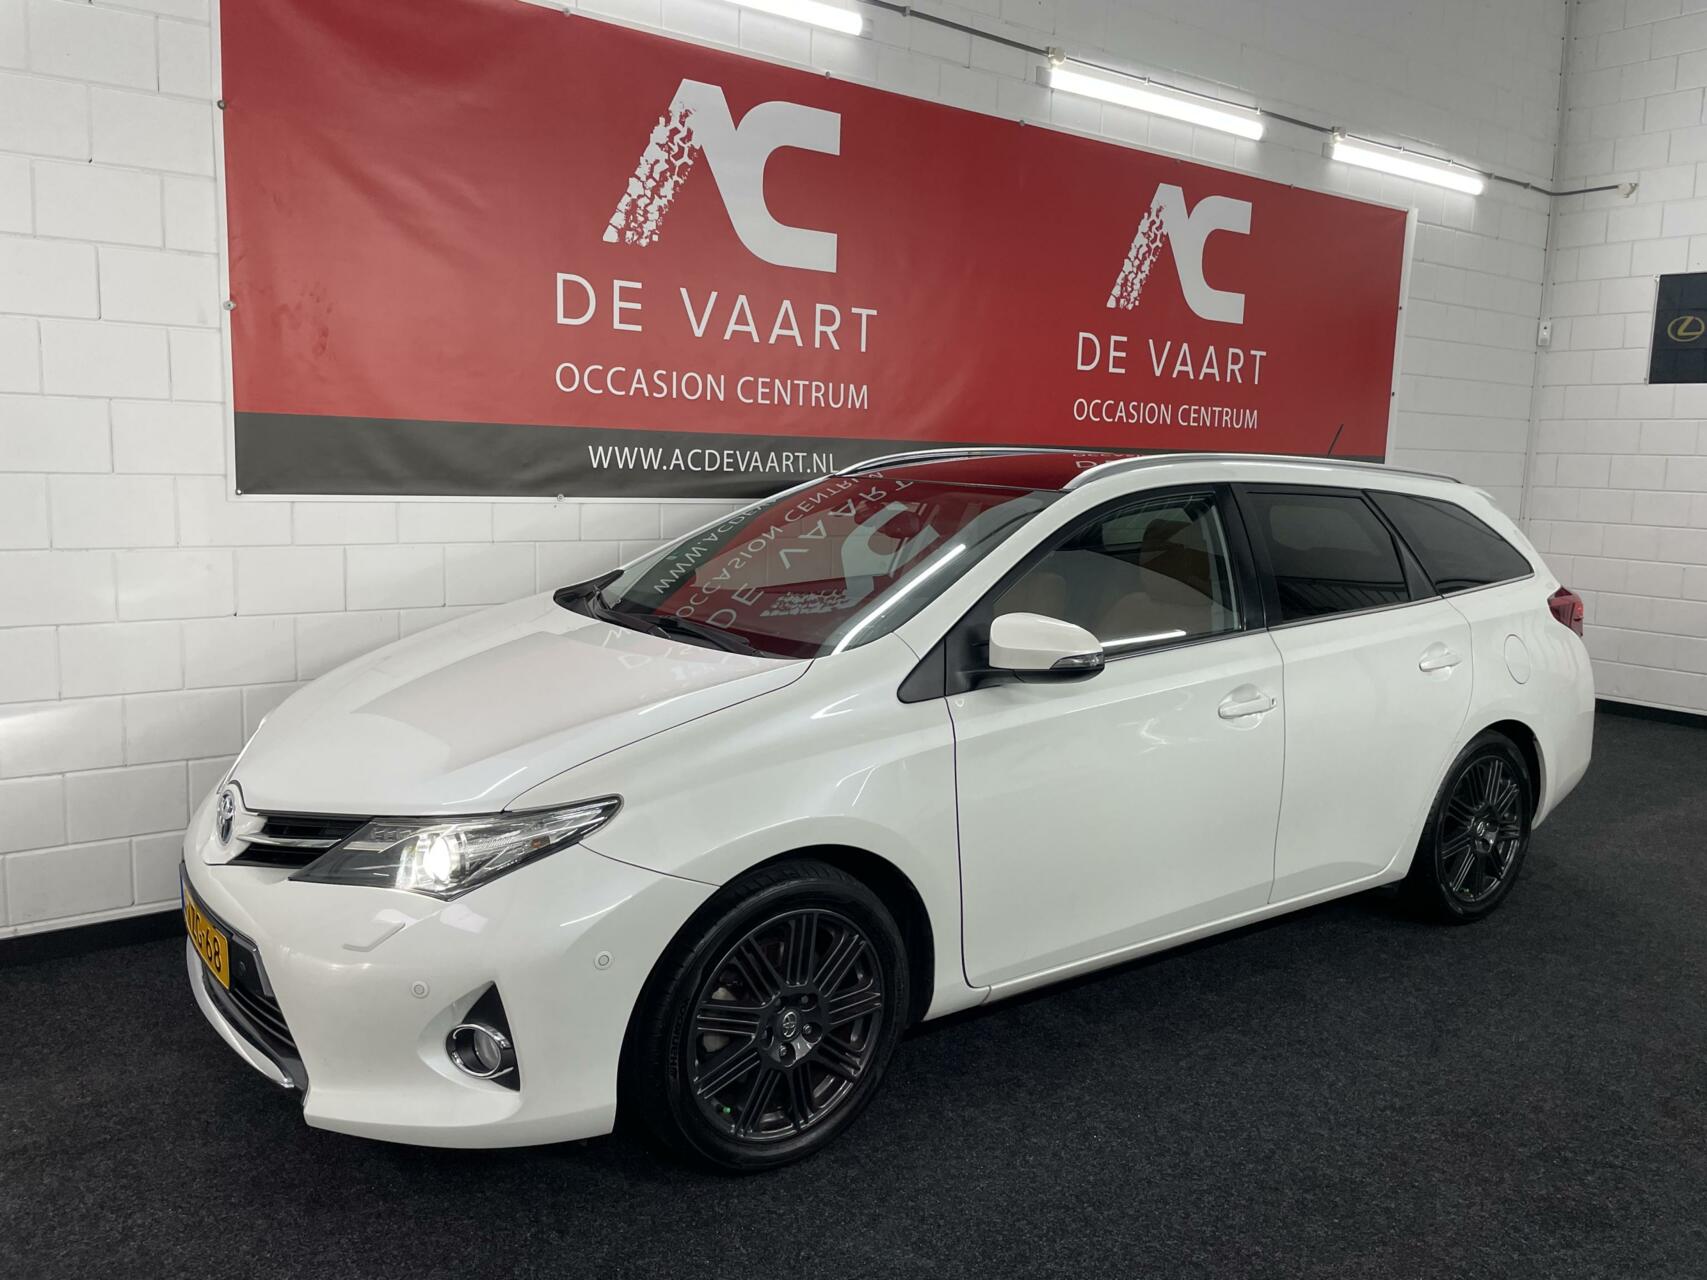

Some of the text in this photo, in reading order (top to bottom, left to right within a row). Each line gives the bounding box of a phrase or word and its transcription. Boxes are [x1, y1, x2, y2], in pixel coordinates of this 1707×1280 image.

[602, 78, 841, 273] AC
[1106, 182, 1252, 325] AC
[555, 272, 878, 353] DE VAART
[1076, 331, 1267, 385] DE VAART
[555, 362, 868, 409] OCCASION CENTRUM
[1073, 398, 1258, 430] OCCASION CENTRUM
[588, 445, 839, 474] WWW.ACDEVAART.NL
